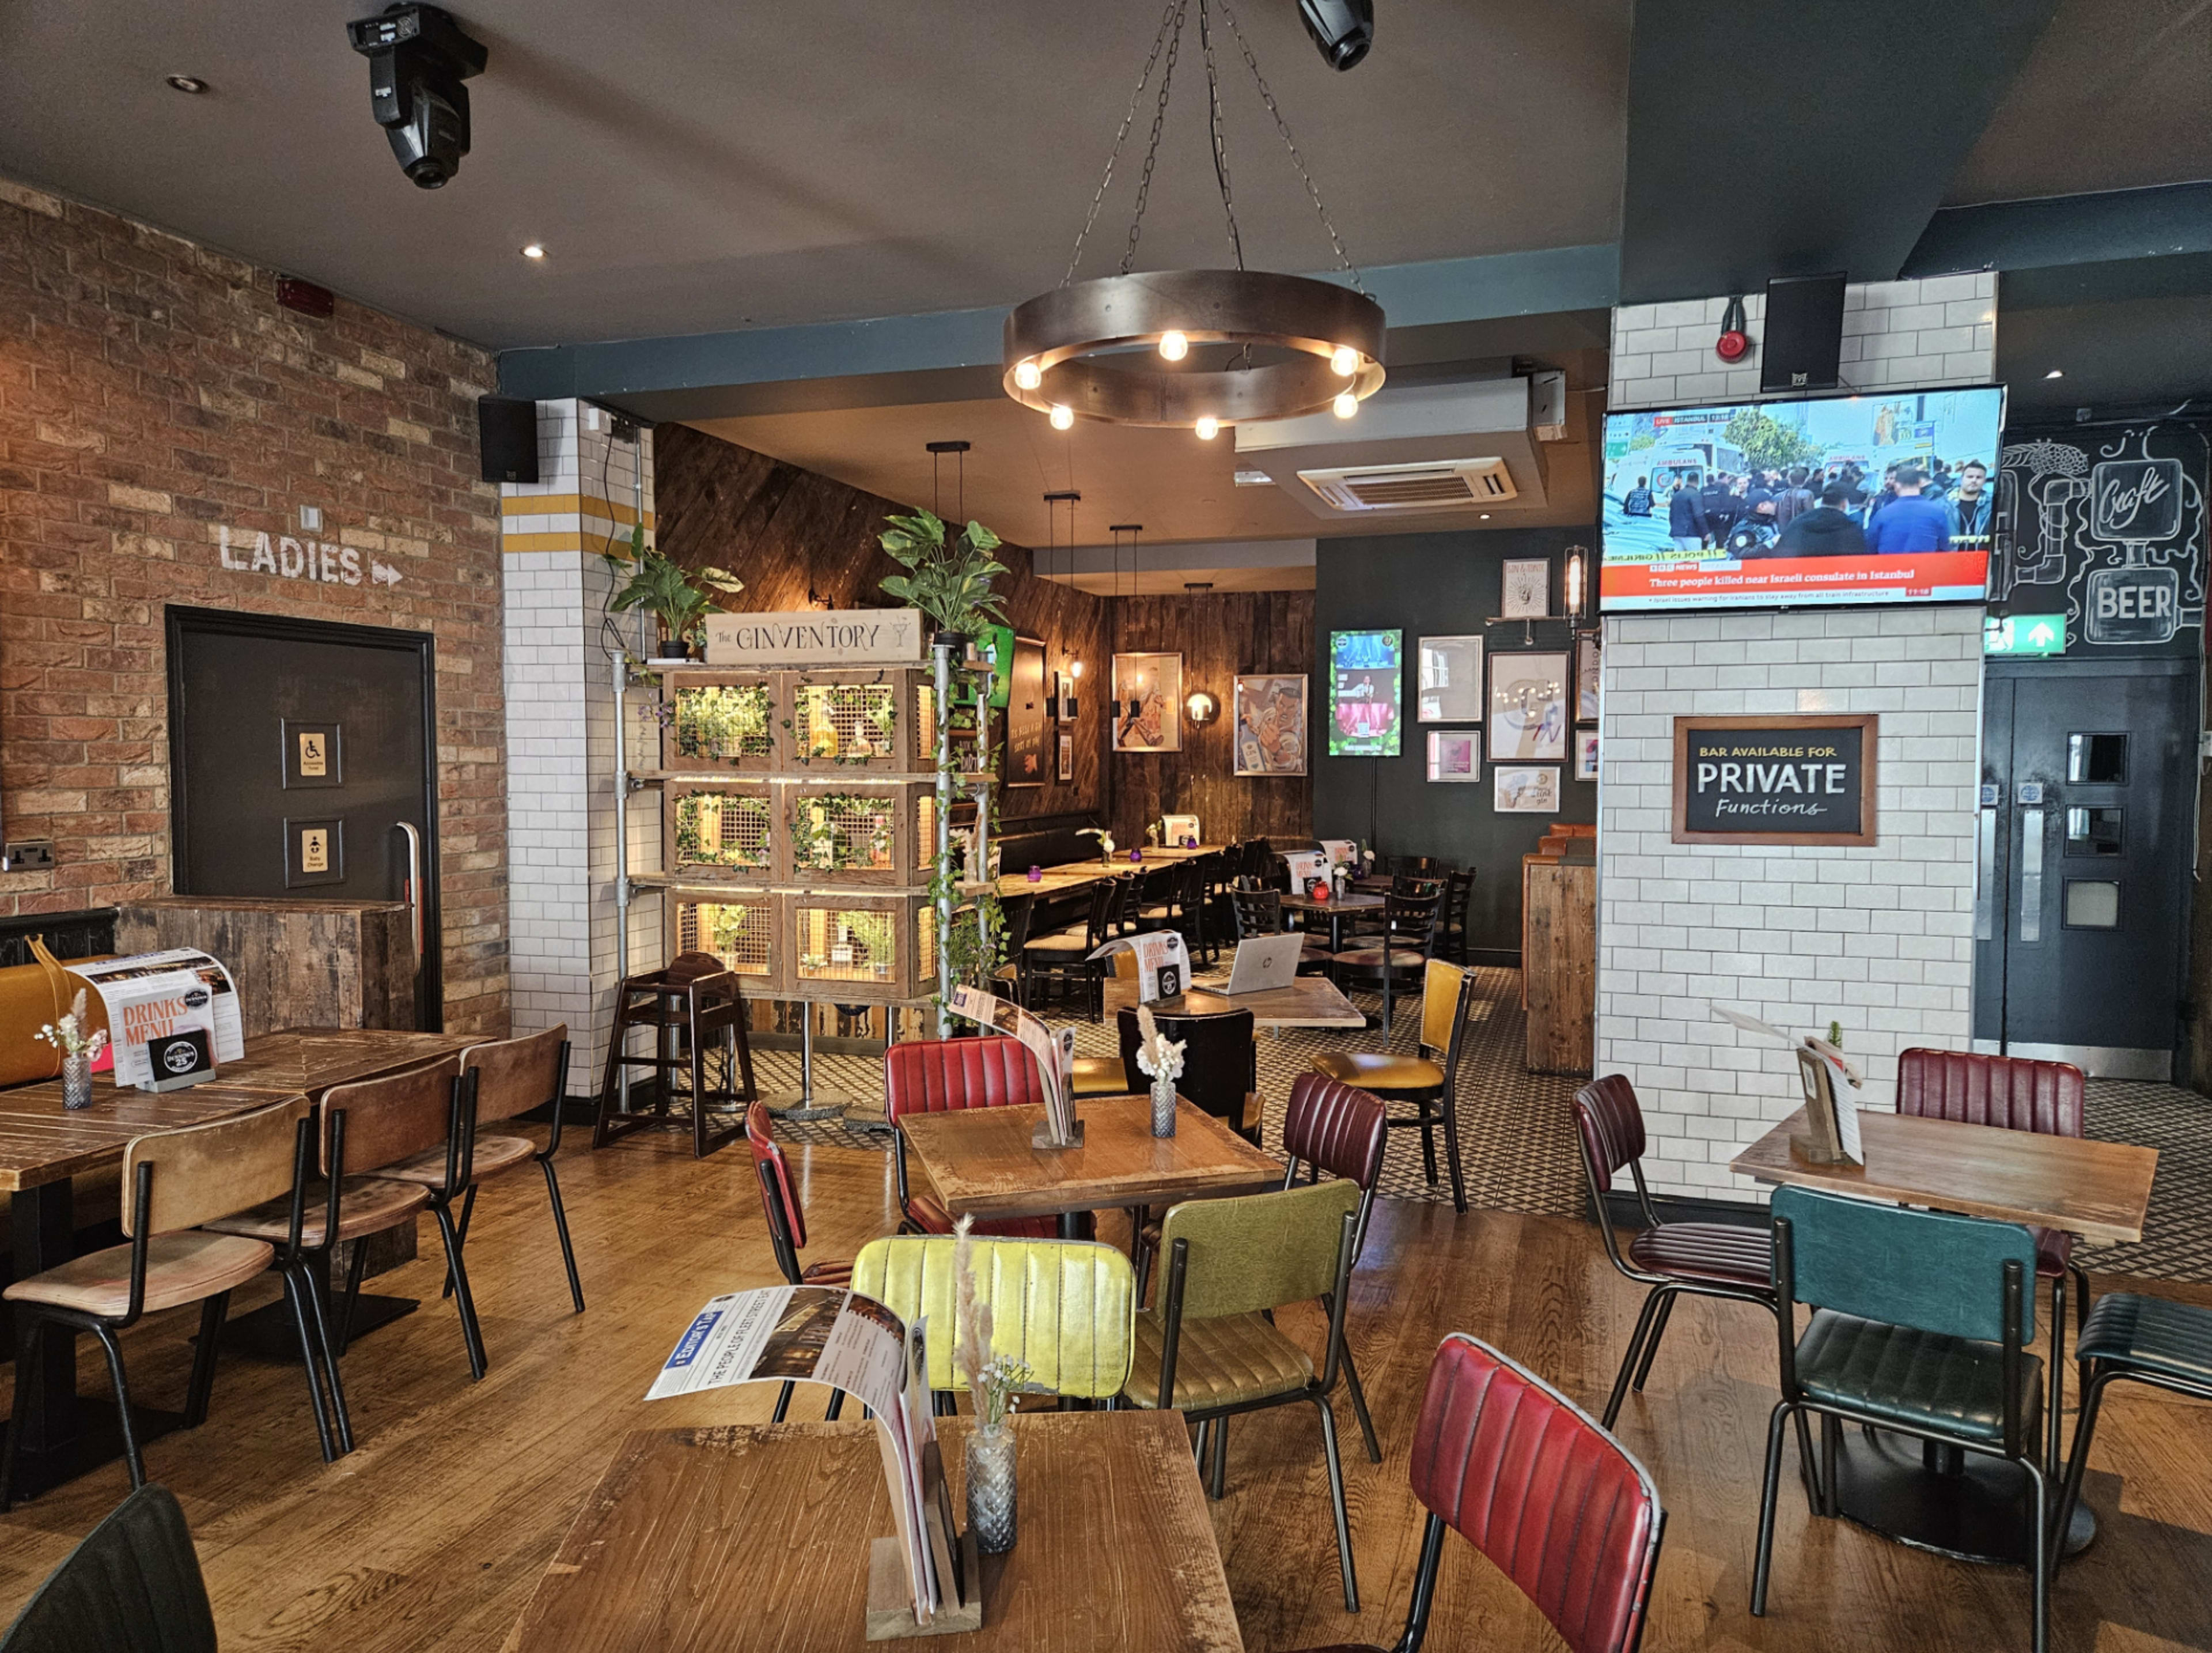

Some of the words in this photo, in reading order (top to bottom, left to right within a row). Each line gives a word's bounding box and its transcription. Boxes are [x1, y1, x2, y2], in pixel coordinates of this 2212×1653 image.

[2099, 467, 2169, 529] Craft
[219, 525, 362, 587] LADIES
[1649, 578, 1677, 588] Three
[1680, 577, 1713, 588] people
[1714, 576, 1743, 584] killed
[1770, 573, 1802, 583] Israeli
[1804, 572, 1854, 582] consulate
[1857, 570, 1868, 580] in
[1870, 569, 1914, 579] Istanbul
[2098, 586, 2171, 619] BEER
[715, 631, 732, 643] The
[736, 621, 880, 651] GINVENTORY
[1699, 747, 1728, 757] BAR
[1732, 746, 1804, 758] AVAILABLE
[1808, 746, 1837, 758] FOR
[1698, 762, 1846, 794] PRIVATE
[1715, 798, 1827, 818] Functions
[123, 996, 188, 1027] DRINKS
